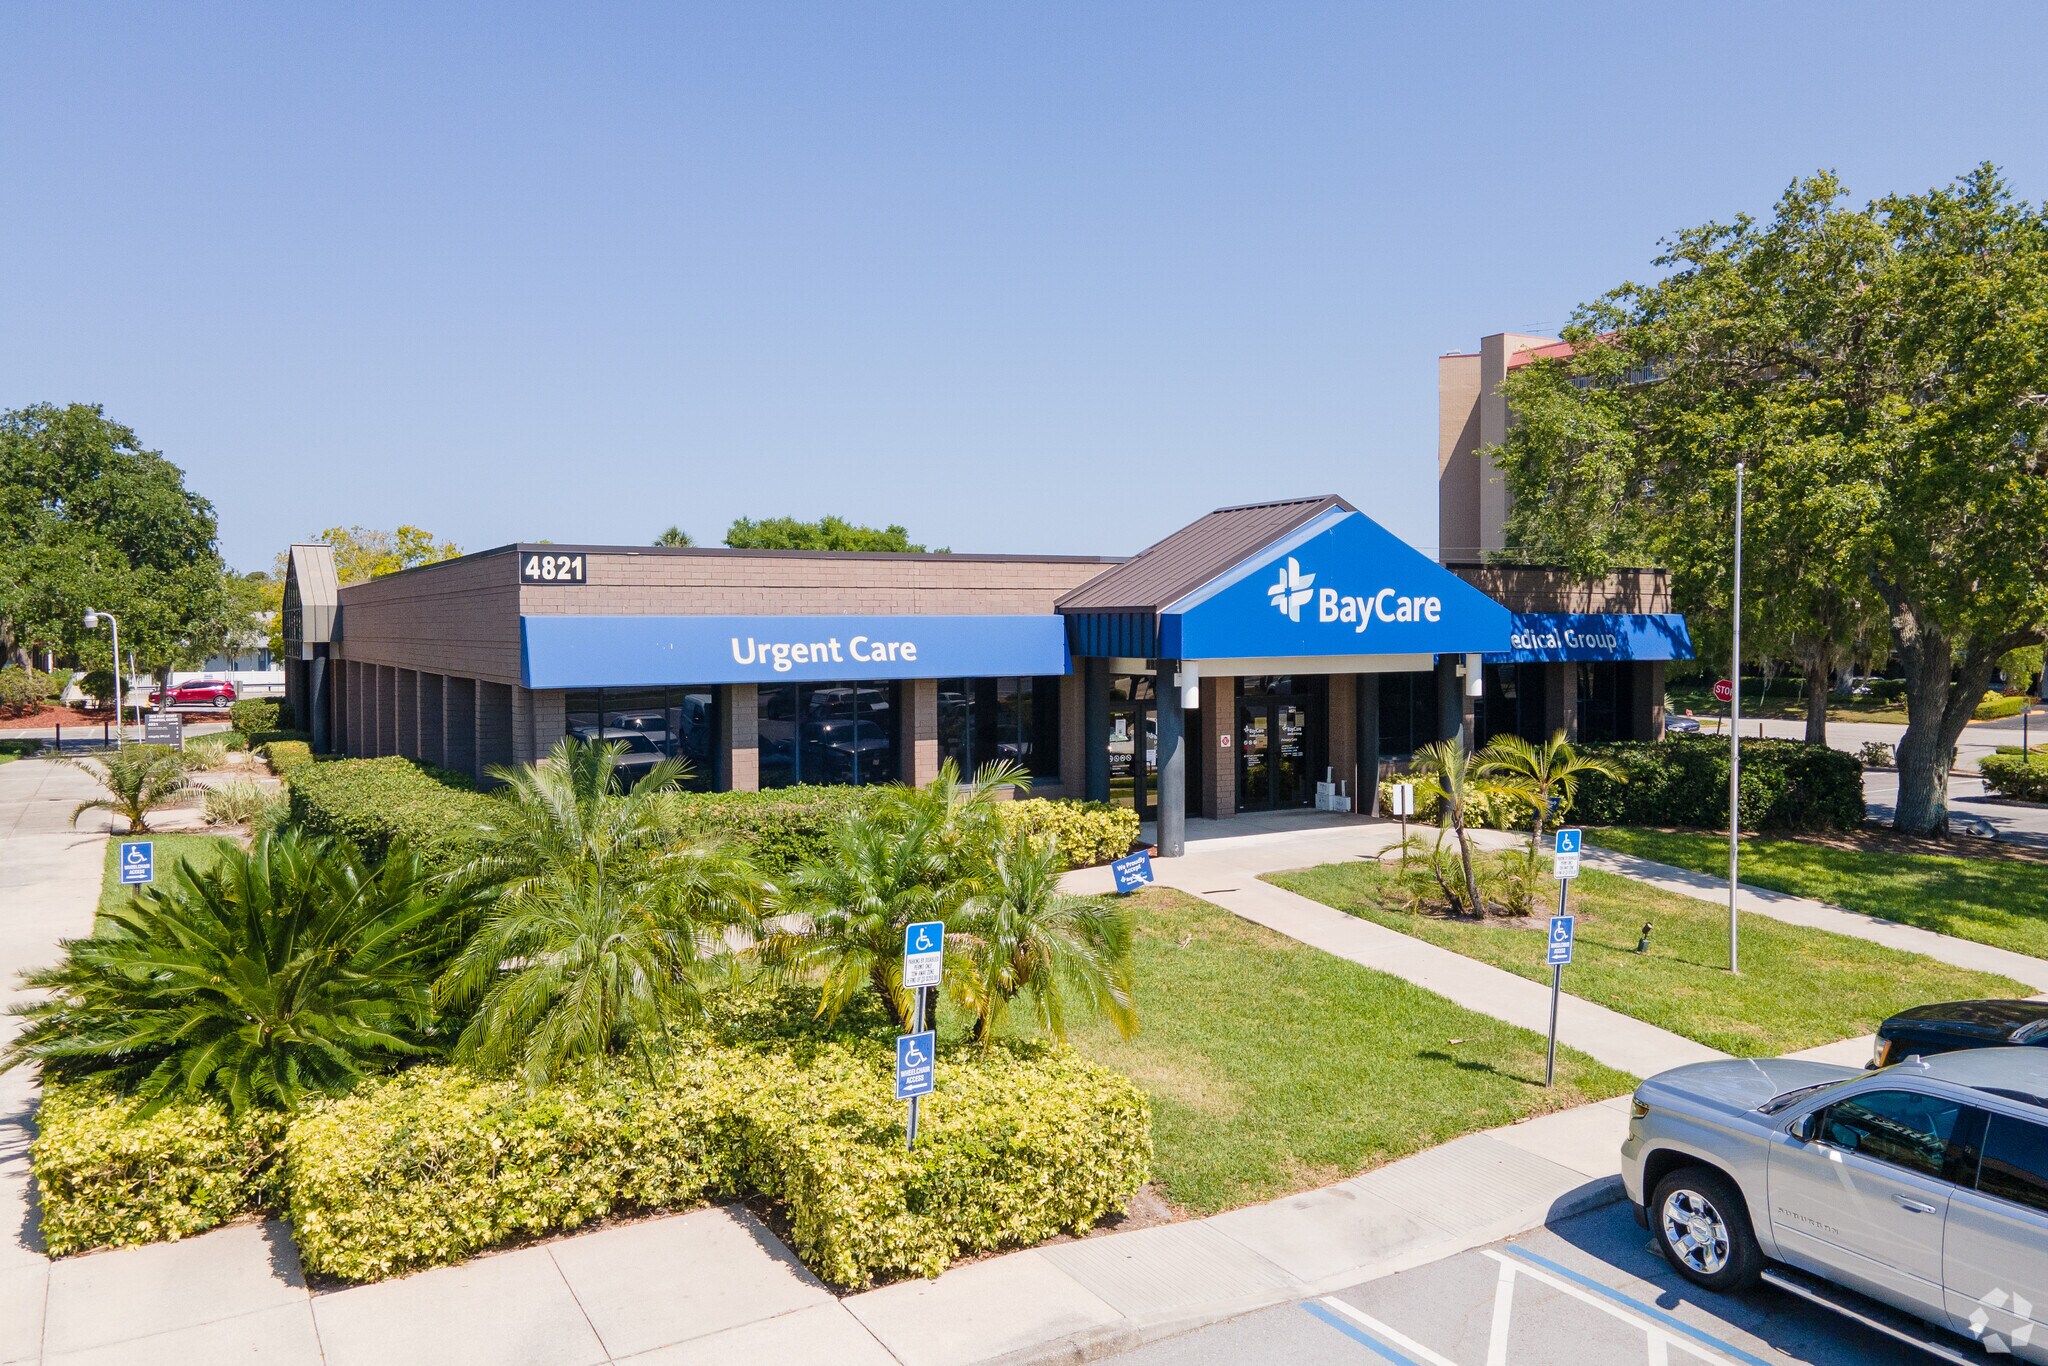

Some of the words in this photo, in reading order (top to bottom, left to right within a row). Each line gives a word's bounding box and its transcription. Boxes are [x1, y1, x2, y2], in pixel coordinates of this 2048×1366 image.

[525, 555, 582, 580] 4821
[1319, 588, 1442, 634] BayCare
[1510, 627, 1562, 650] edical
[1564, 628, 1617, 653] Group
[731, 637, 844, 672] Urgent
[850, 635, 917, 662] Care
[1715, 684, 1732, 696] STO
[900, 1065, 931, 1078] WHEELCHAIR
[905, 1074, 925, 1085] ACCESS
